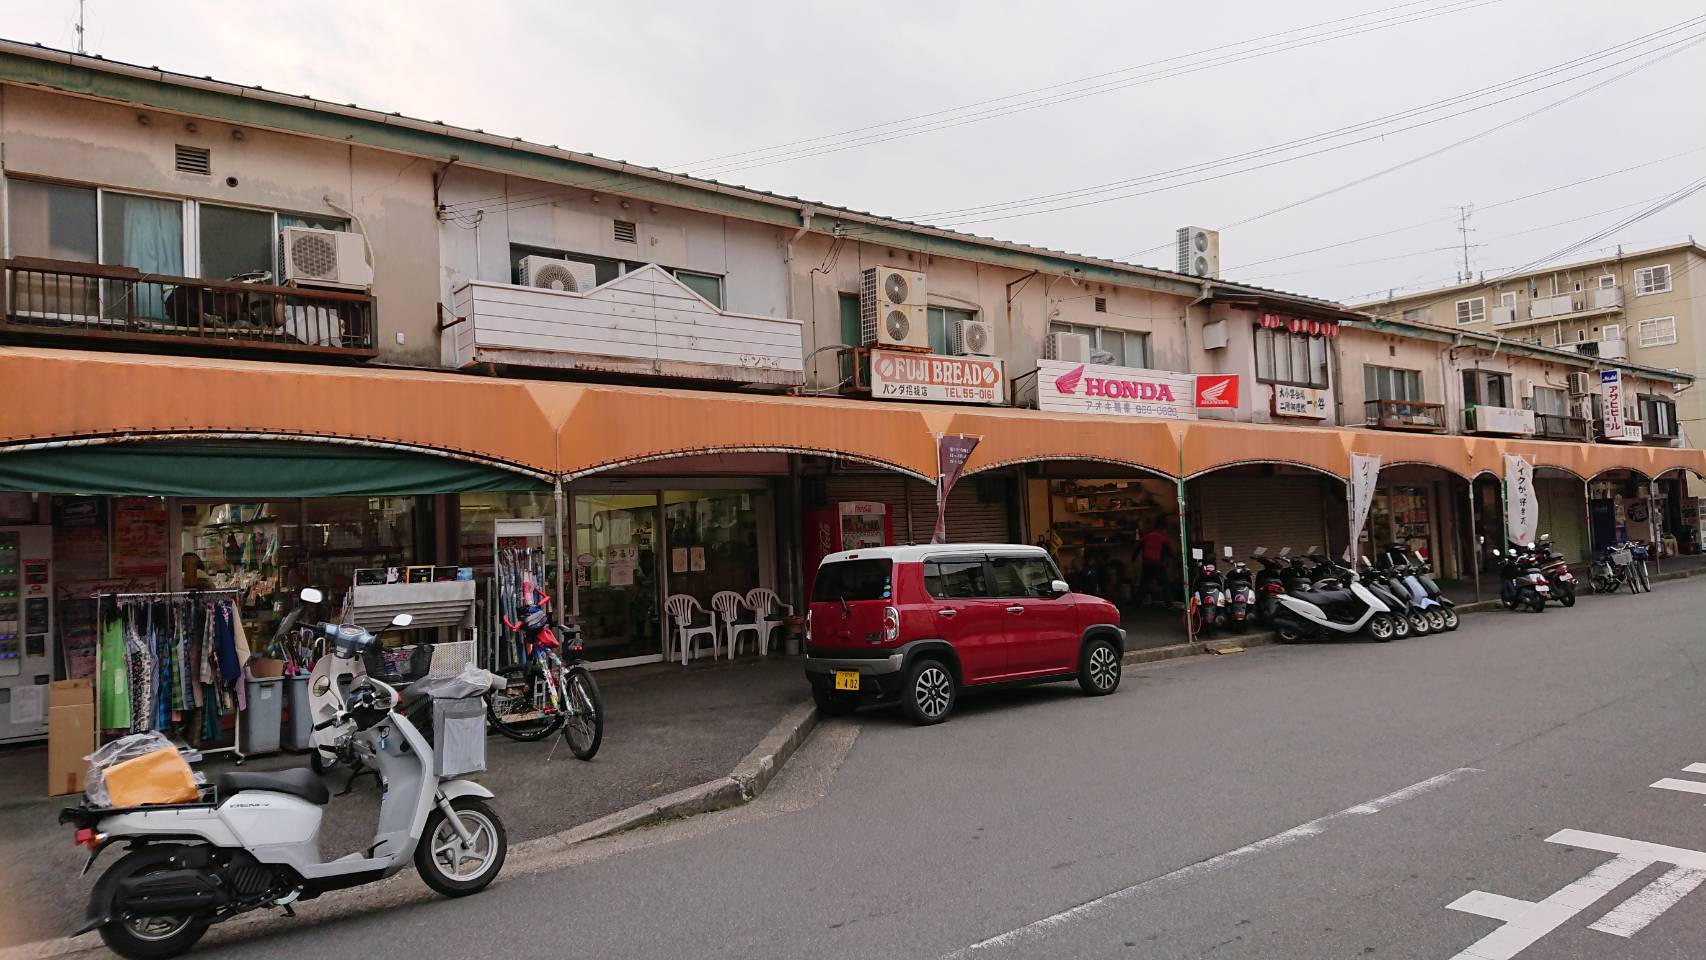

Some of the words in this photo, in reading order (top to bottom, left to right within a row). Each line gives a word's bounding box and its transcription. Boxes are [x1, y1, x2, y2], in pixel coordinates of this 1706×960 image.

[895, 358, 930, 381] FUJI
[932, 361, 982, 385] BREAD
[1084, 377, 1176, 402] HONDA
[1608, 385, 1621, 431] アサヒビール
